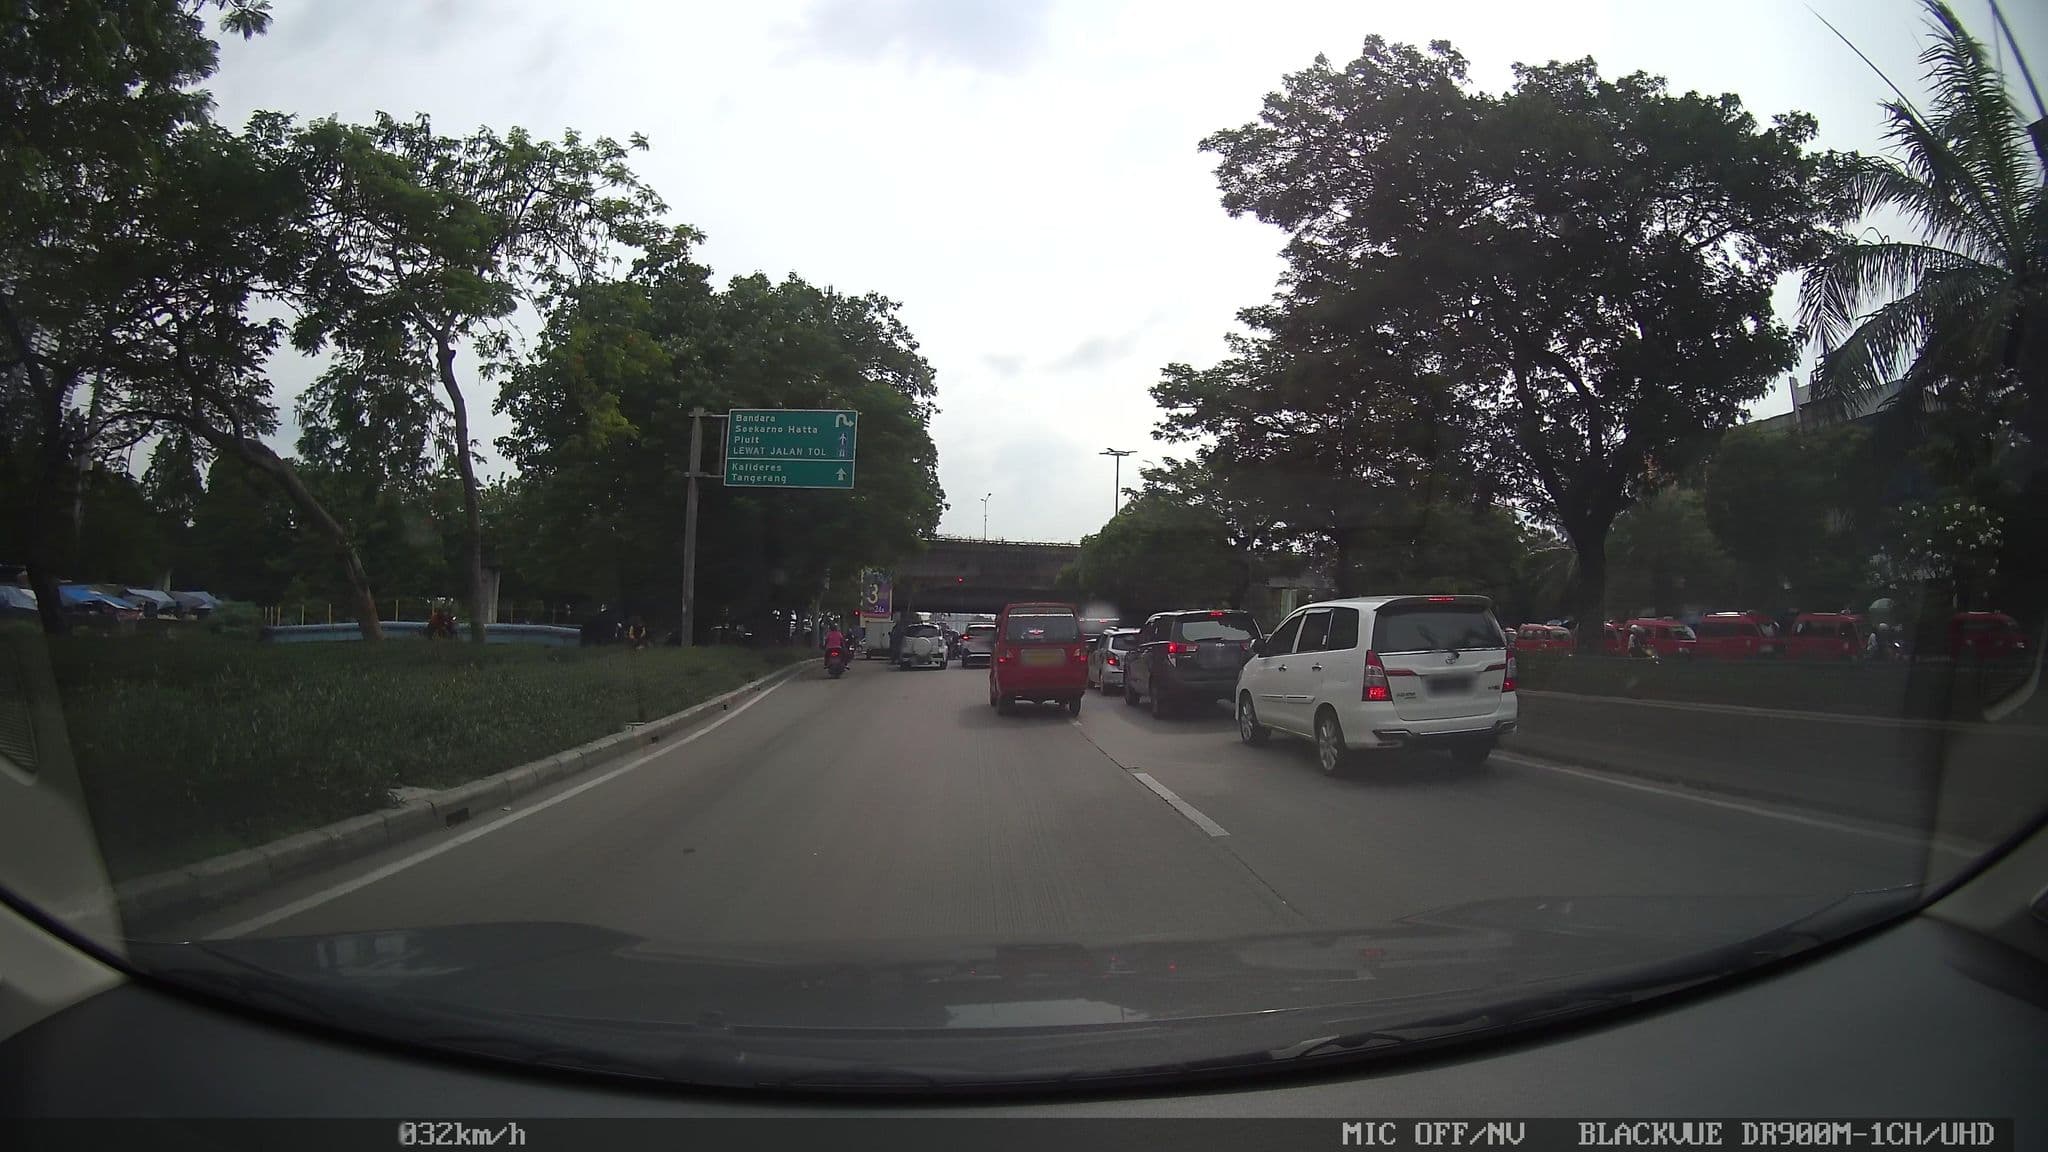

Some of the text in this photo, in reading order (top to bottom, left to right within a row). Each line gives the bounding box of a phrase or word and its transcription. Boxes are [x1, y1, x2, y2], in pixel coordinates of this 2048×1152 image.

[736, 414, 776, 423] Bandara
[735, 425, 818, 434] Soekarno Hatta
[734, 436, 760, 444] Pluit
[733, 447, 826, 456] LEWAT JALAN TOL
[732, 463, 782, 471] Kalideres
[732, 473, 787, 484] Tangerang
